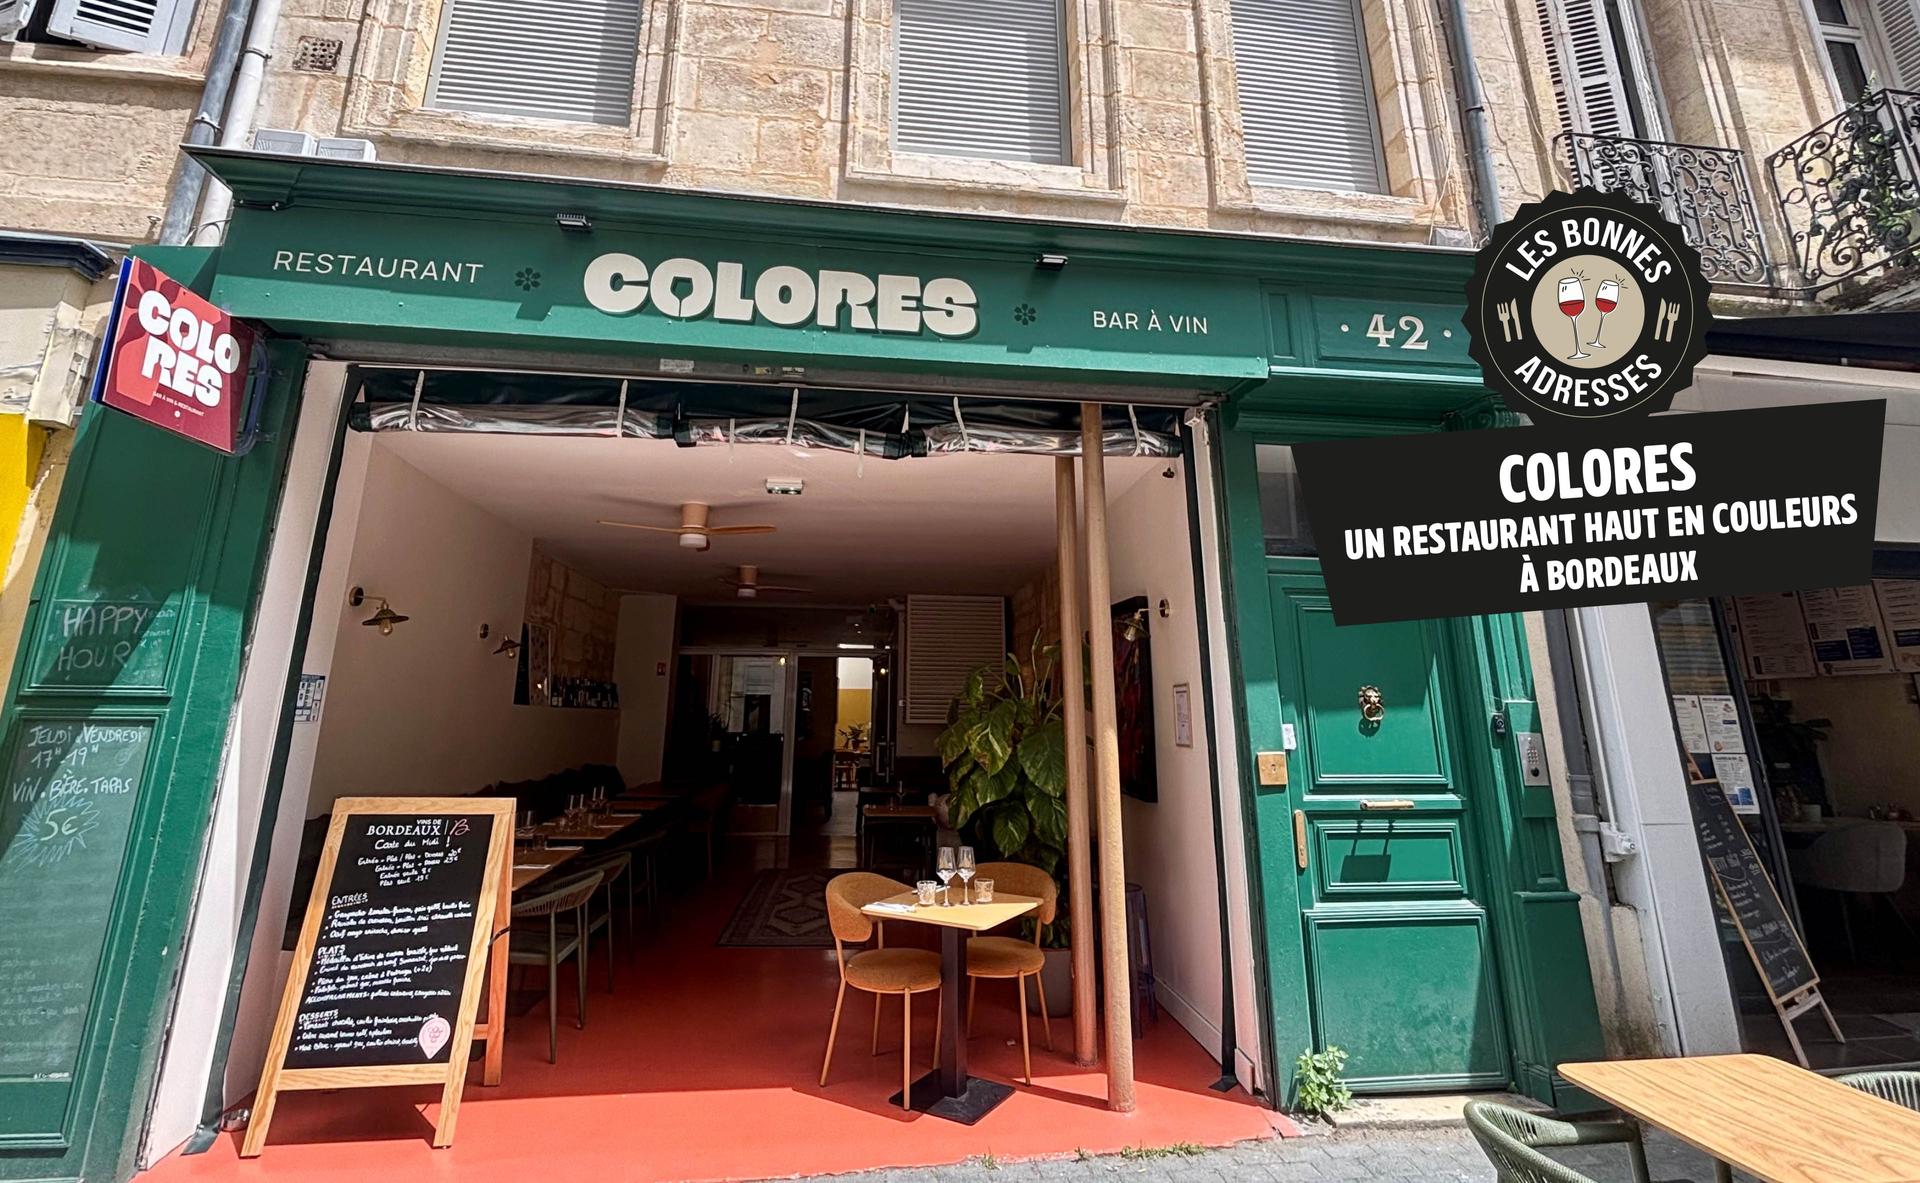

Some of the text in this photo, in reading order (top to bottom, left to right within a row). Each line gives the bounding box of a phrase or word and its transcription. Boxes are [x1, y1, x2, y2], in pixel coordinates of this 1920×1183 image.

[273, 251, 484, 283] RESTAURANT
[583, 252, 977, 337] COLORES
[138, 290, 240, 374] COLO
[1093, 309, 1208, 334] BAR À VIN
[1366, 313, 1428, 350] 42
[141, 335, 222, 407] RES
[63, 605, 148, 637] HAPPY
[58, 641, 131, 671] HOUR
[90, 776, 132, 794] TAPAS
[366, 825, 441, 836] BORDEAUX
[374, 839, 400, 850] Carte
[404, 839, 416, 848] du
[422, 837, 439, 846] Midi
[386, 854, 398, 863] Plat
[404, 852, 416, 861] Plat
[402, 862, 415, 870] Plat
[379, 879, 393, 887] Plat
[318, 945, 346, 956] PLATS
